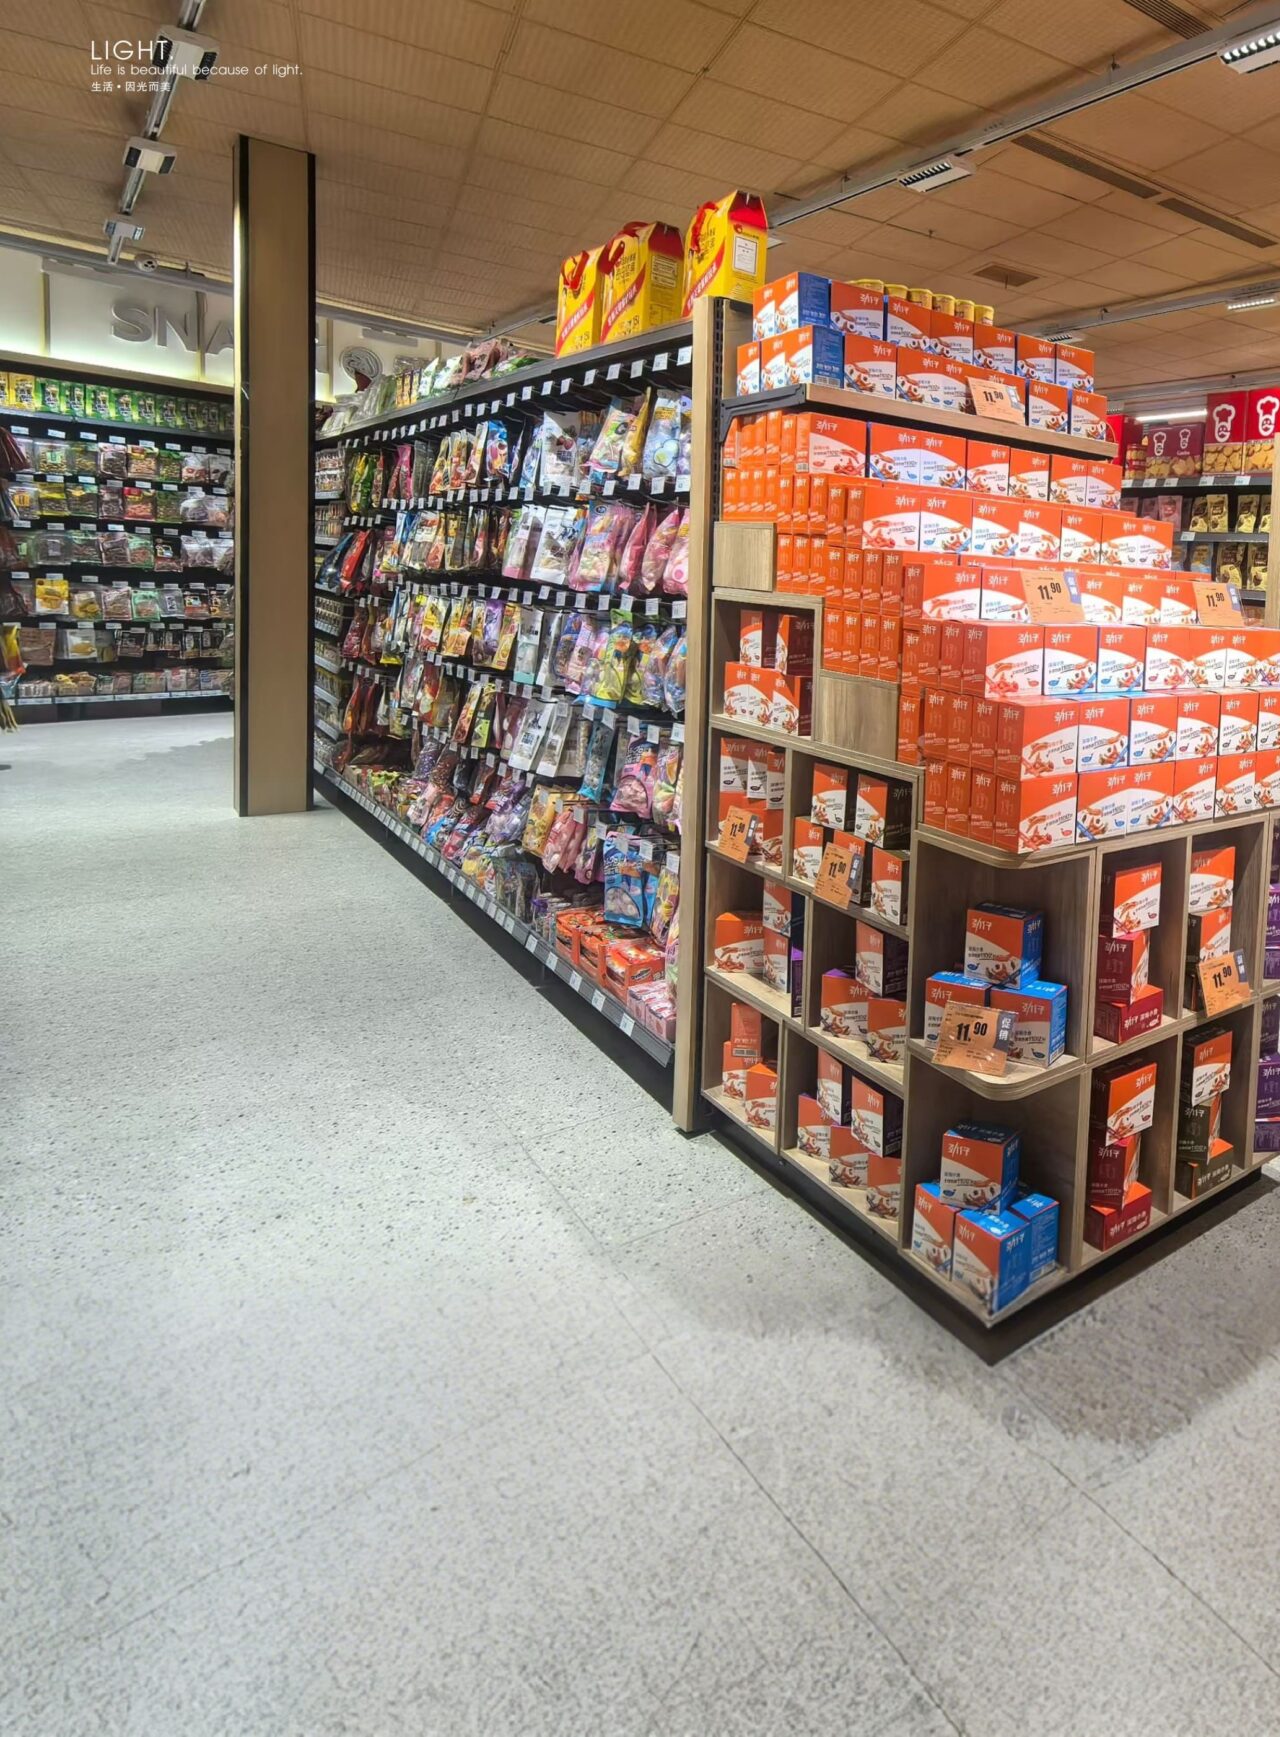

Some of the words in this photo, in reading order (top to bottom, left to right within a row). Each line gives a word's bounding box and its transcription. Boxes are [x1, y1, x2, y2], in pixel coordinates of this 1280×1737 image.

[1038, 581, 1061, 601] 11.90
[1212, 965, 1232, 989] 11.90
[956, 1021, 988, 1042] 11.90
